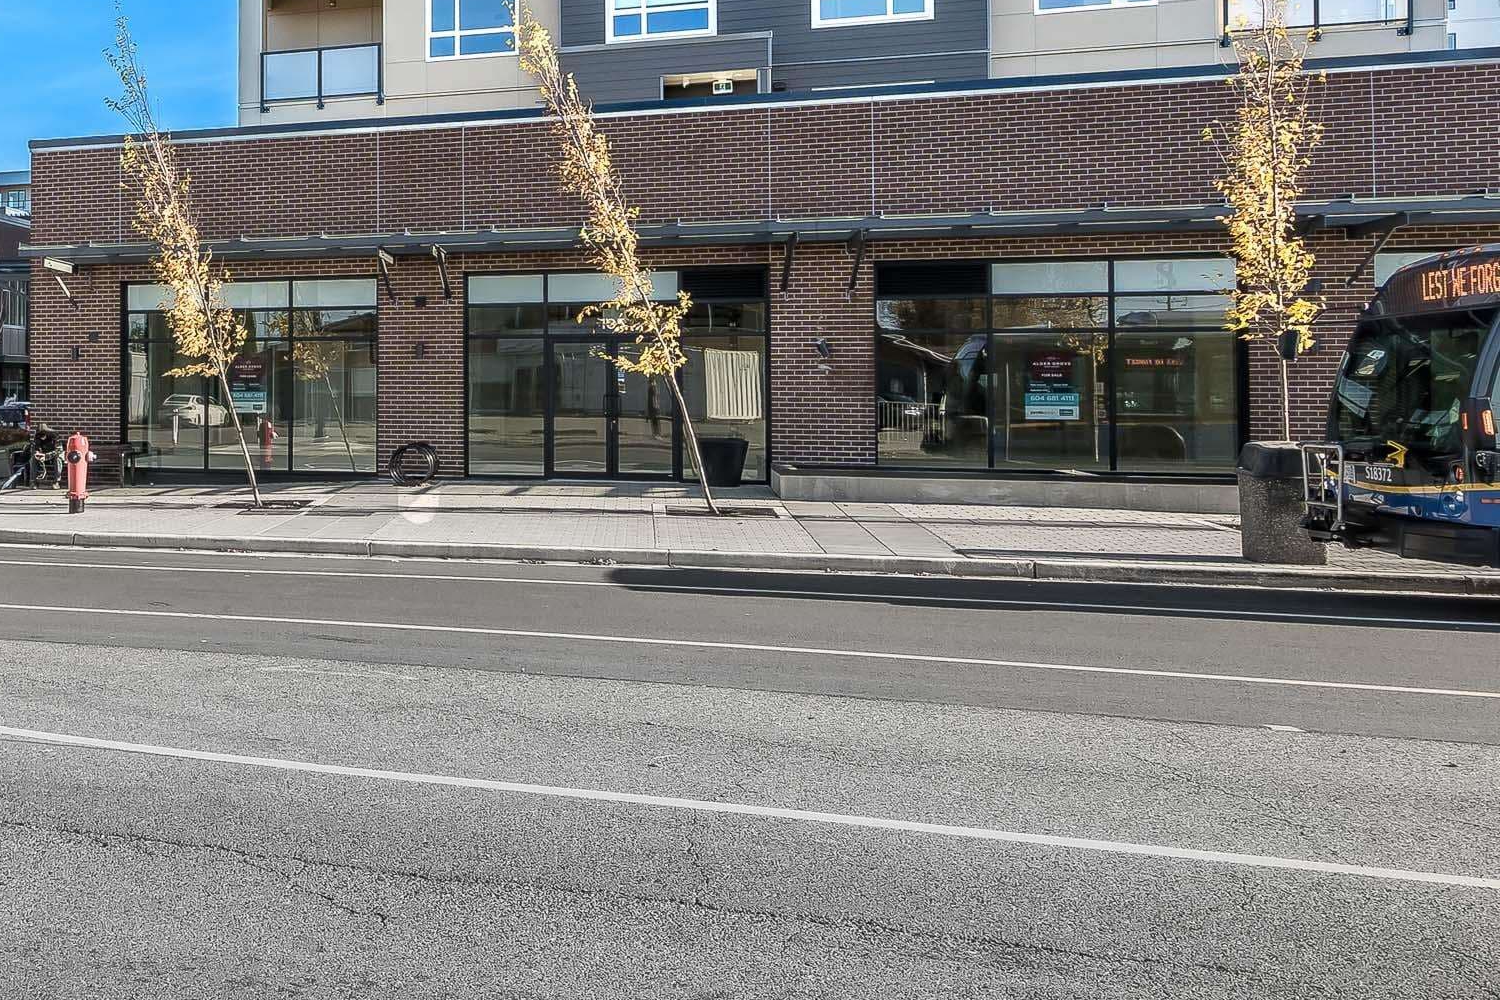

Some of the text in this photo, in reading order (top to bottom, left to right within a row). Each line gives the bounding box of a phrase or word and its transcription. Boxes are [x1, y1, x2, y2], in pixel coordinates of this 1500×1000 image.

[1422, 269, 1448, 300] LEST
[1451, 266, 1468, 297] WE
[1365, 466, 1393, 482] S18372
